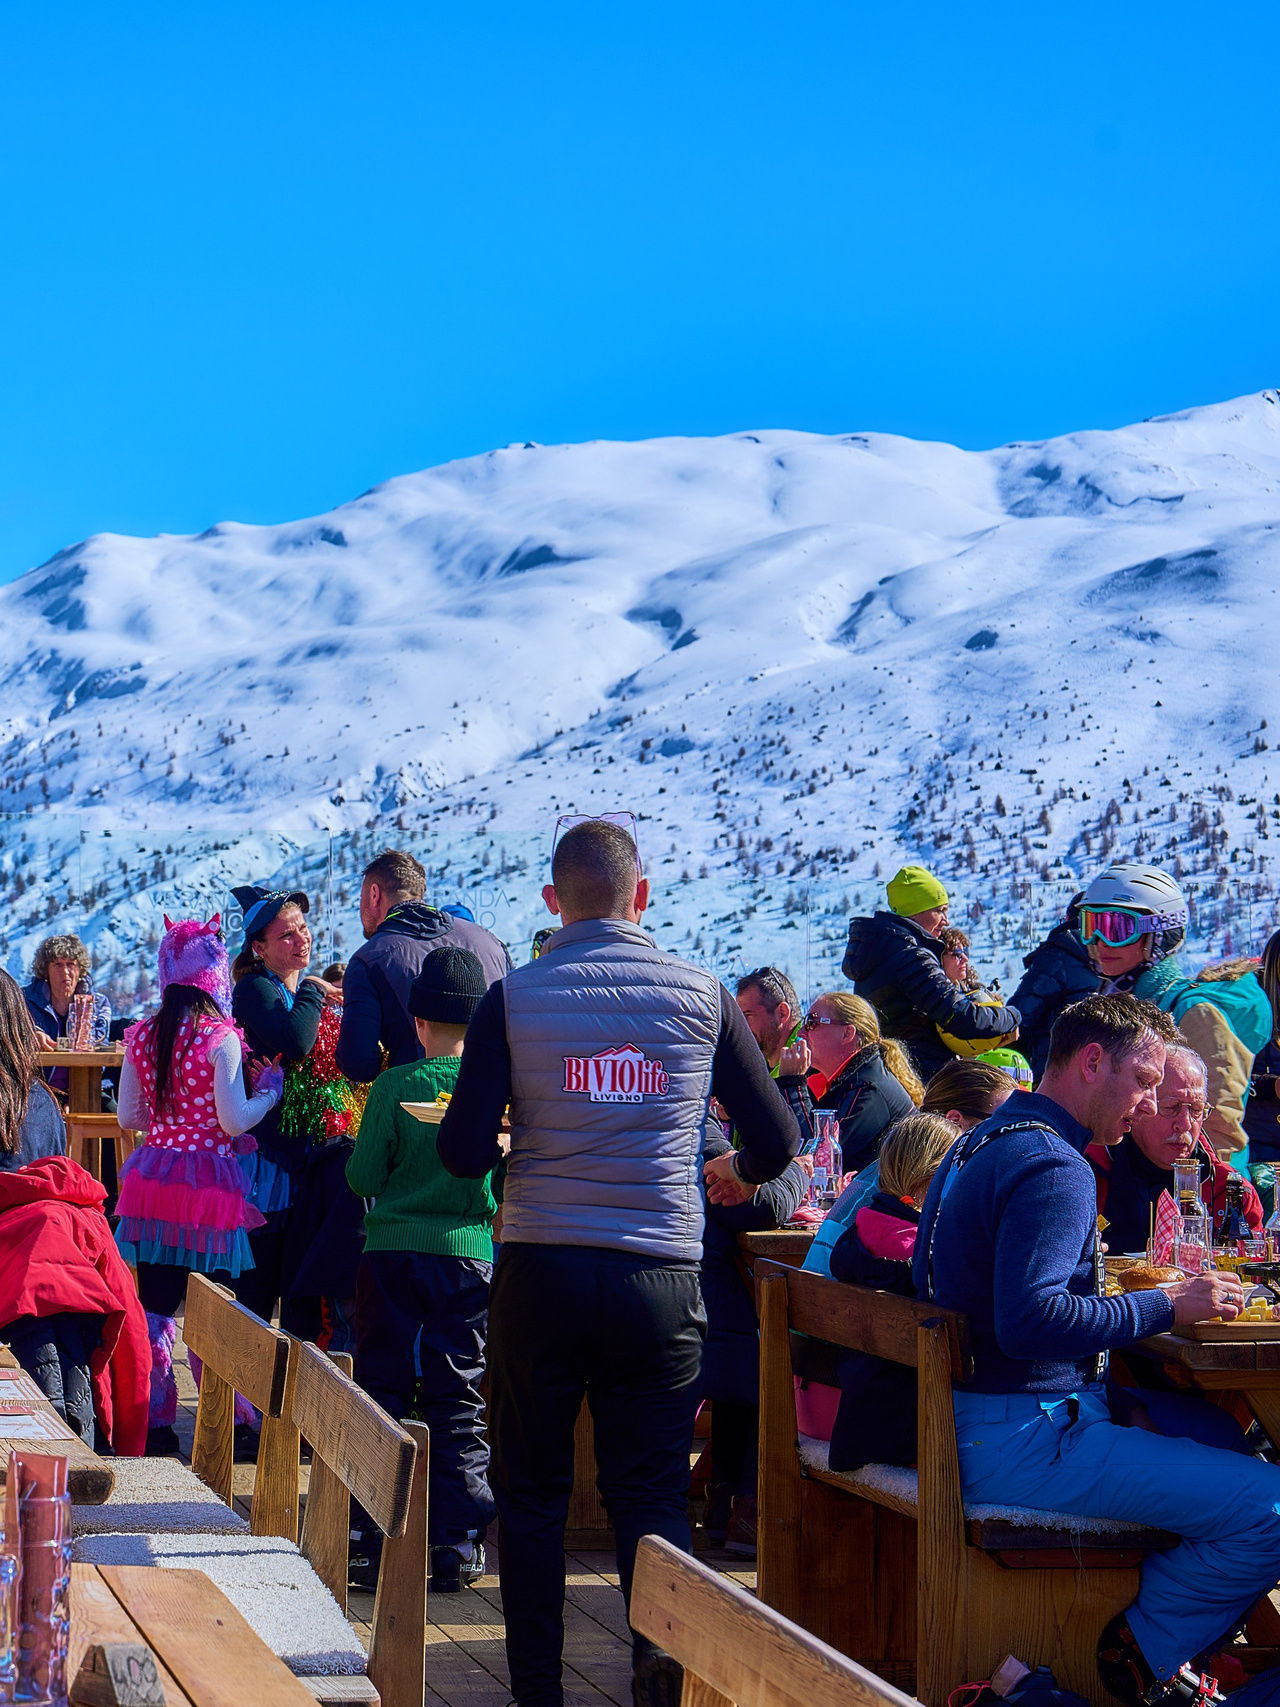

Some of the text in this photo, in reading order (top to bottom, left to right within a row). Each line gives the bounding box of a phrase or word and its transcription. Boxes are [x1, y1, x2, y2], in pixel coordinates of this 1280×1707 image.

[146, 890, 243, 909] VERAND
[431, 889, 511, 908] RANDA
[594, 1094, 641, 1102] LIVIGNO
[349, 1557, 370, 1567] AD
[459, 1563, 484, 1572] HEAD
